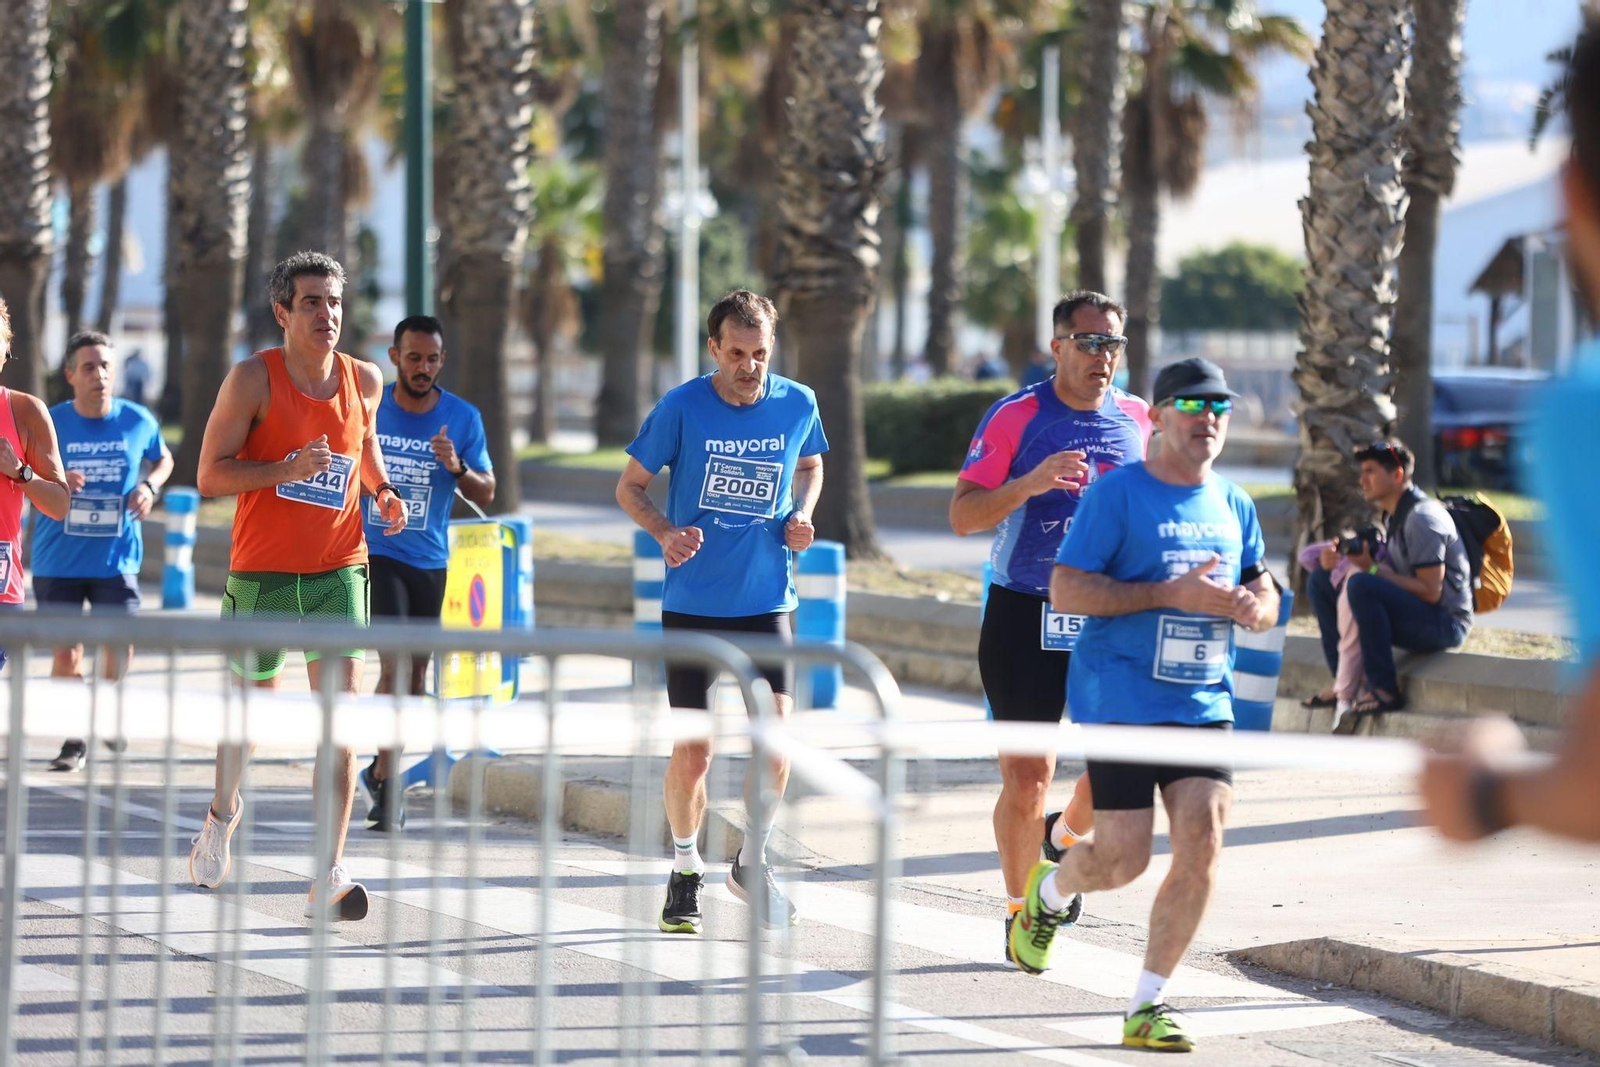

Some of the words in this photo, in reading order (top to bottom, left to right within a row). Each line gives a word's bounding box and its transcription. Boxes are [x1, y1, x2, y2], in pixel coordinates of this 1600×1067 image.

[66, 438, 128, 455] mayoral
[705, 433, 785, 457] mayoral
[720, 468, 745, 477] Solidaria
[713, 477, 769, 498] 2006
[90, 512, 100, 523] 0
[1053, 616, 1087, 633] 15
[1194, 643, 1206, 661] 6
